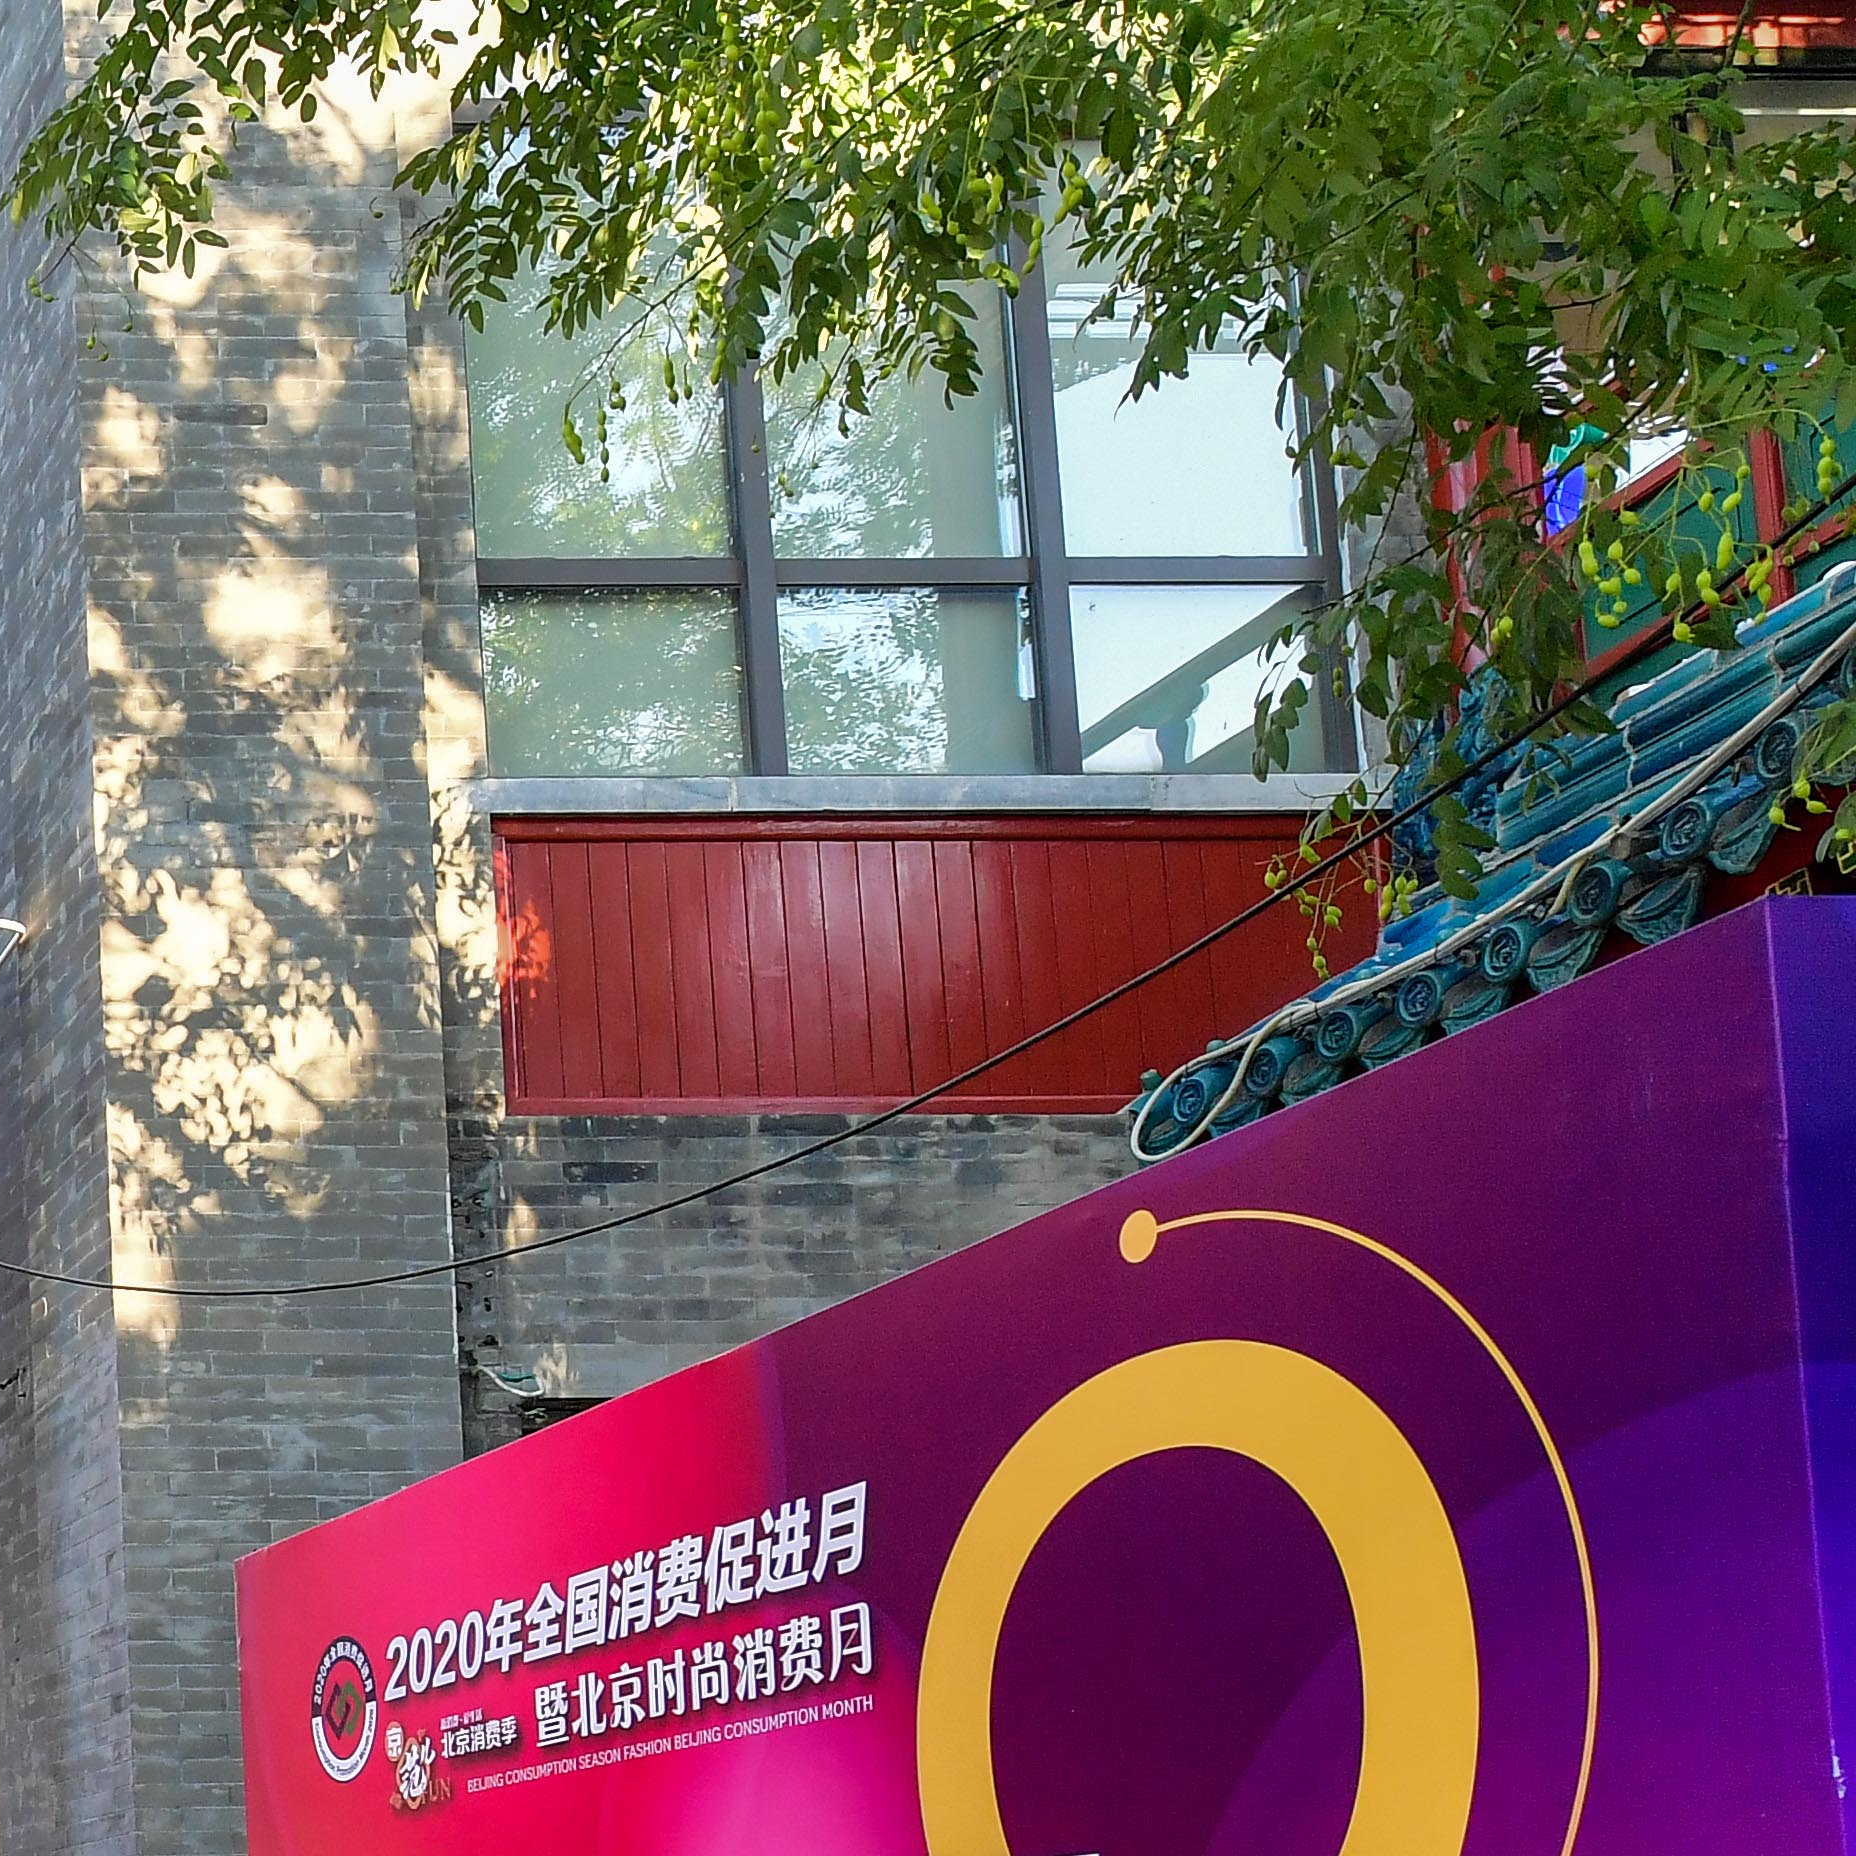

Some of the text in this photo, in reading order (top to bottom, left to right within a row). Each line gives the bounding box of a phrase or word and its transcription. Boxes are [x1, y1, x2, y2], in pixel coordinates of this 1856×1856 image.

[384, 1481, 868, 1702] 2020年全国消费促进月
[535, 1602, 873, 1747] 暨北京时尚消费月
[441, 1716, 518, 1758] 北京消费季
[467, 1694, 874, 1793] BEIJING CONSUMPTION SEASON FASHION BEIJING CONSUMPTION MONTH
